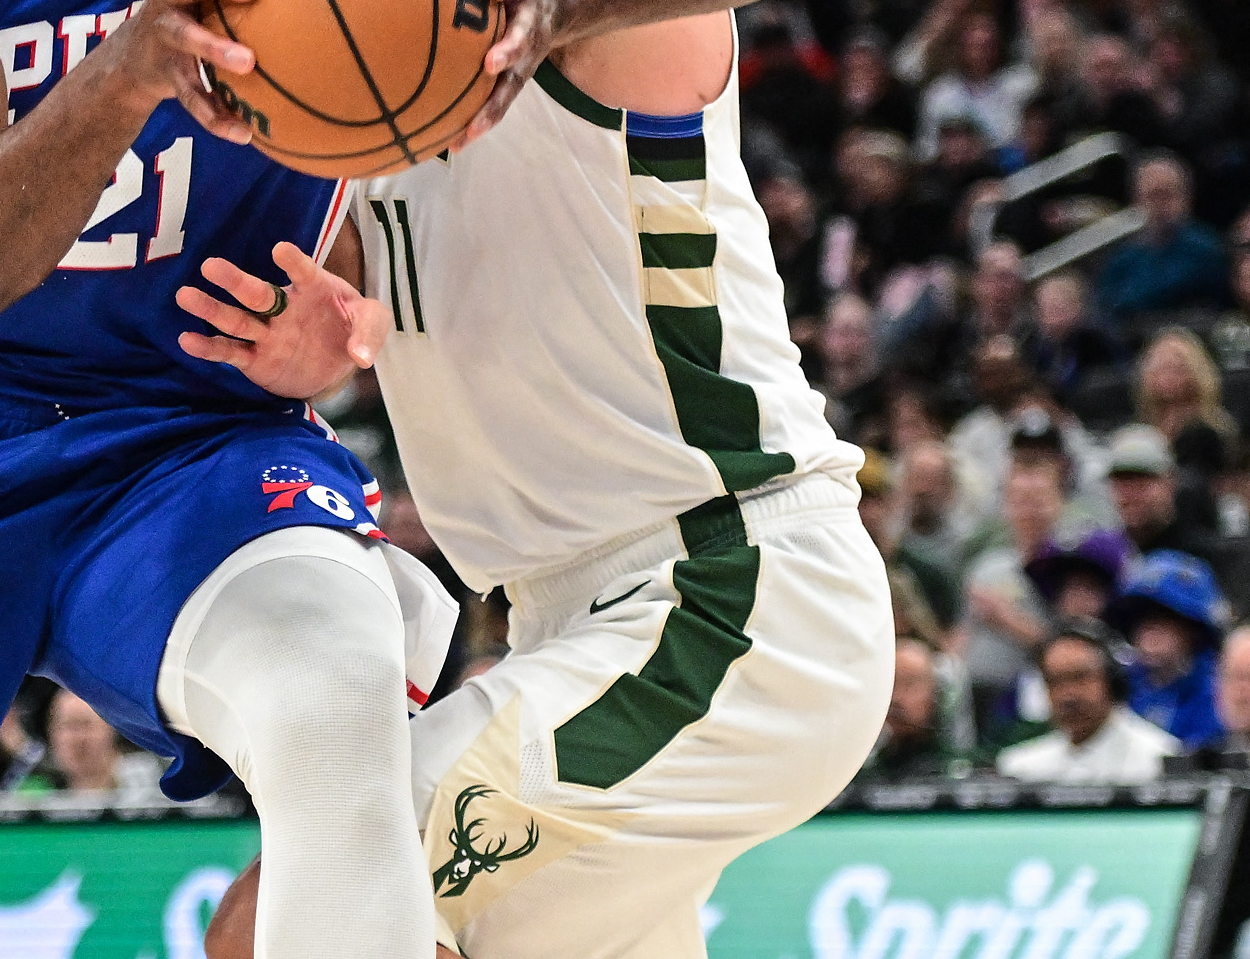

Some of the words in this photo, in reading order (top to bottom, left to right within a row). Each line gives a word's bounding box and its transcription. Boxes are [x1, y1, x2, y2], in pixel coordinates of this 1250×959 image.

[57, 136, 193, 269] 21
[367, 197, 428, 335] 11
[261, 481, 355, 521] 76
